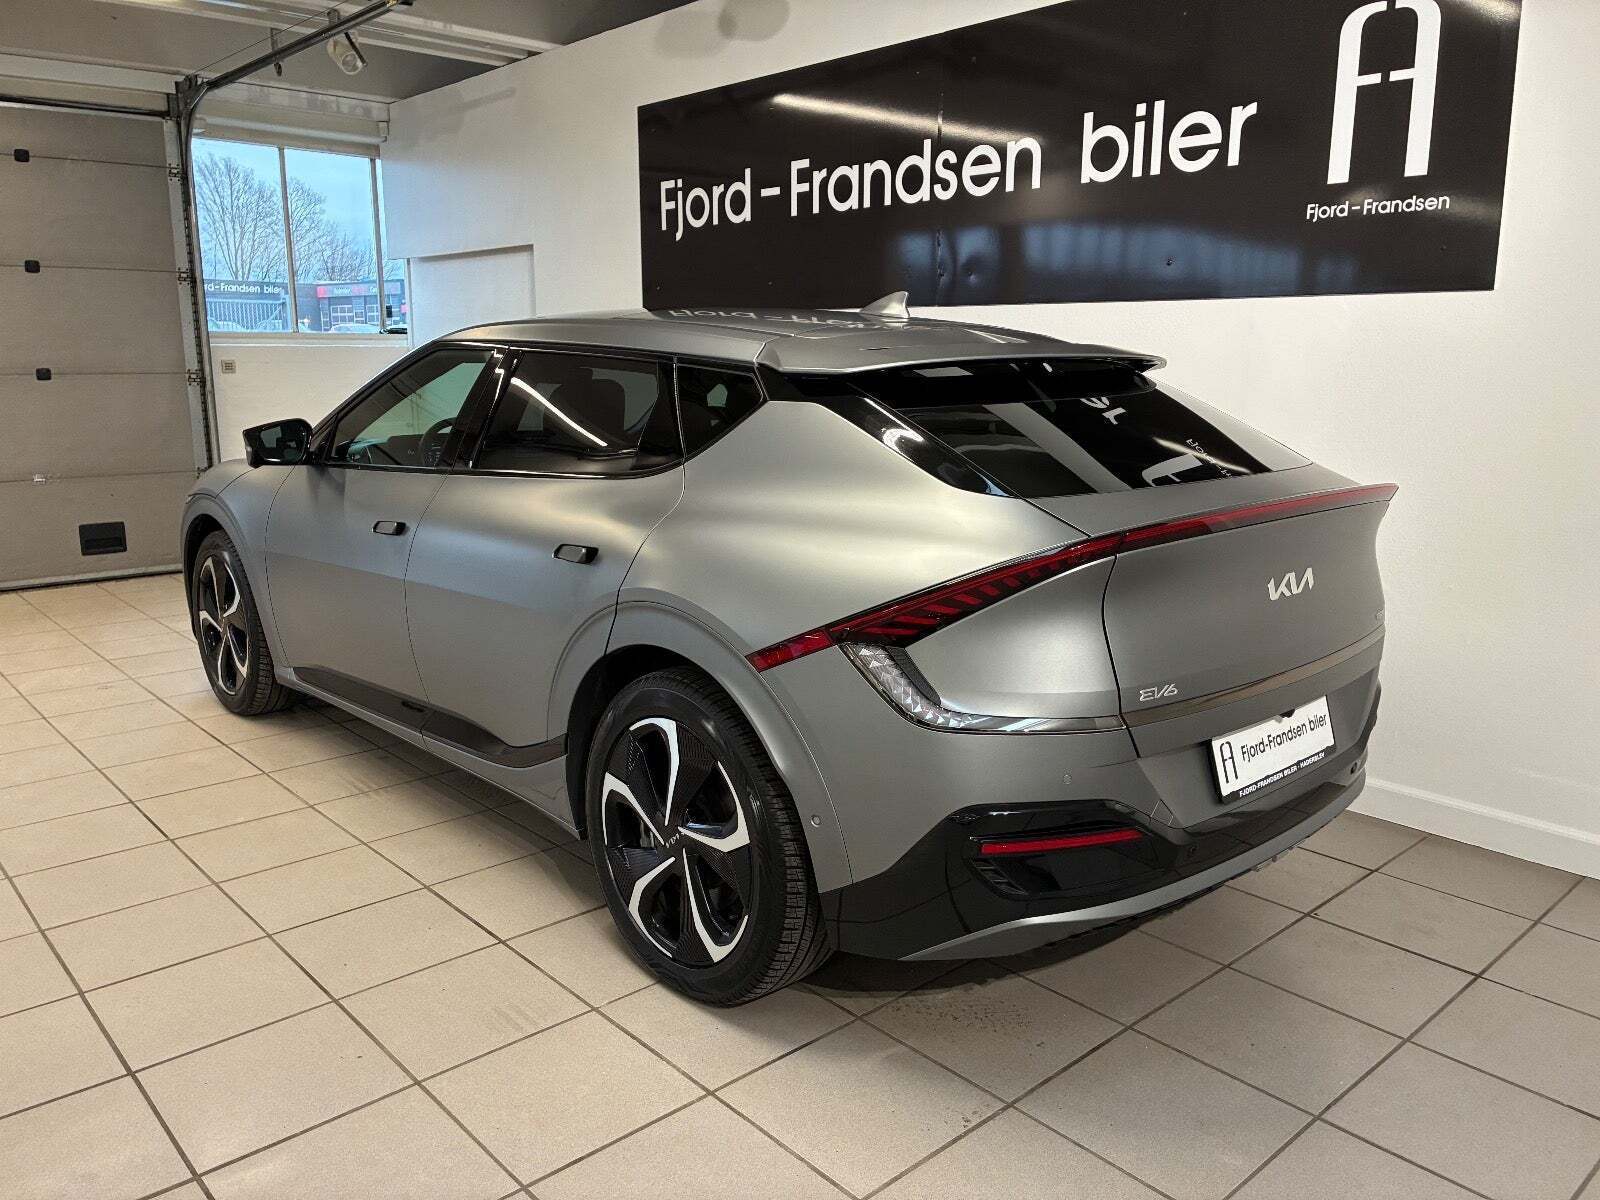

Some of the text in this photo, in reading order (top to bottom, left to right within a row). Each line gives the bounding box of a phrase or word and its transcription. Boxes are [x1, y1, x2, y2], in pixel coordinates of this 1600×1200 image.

[1081, 100, 1257, 183] biler
[1139, 683, 1178, 702] EV6
[1240, 713, 1328, 763] Fjord-Frandsen biler
